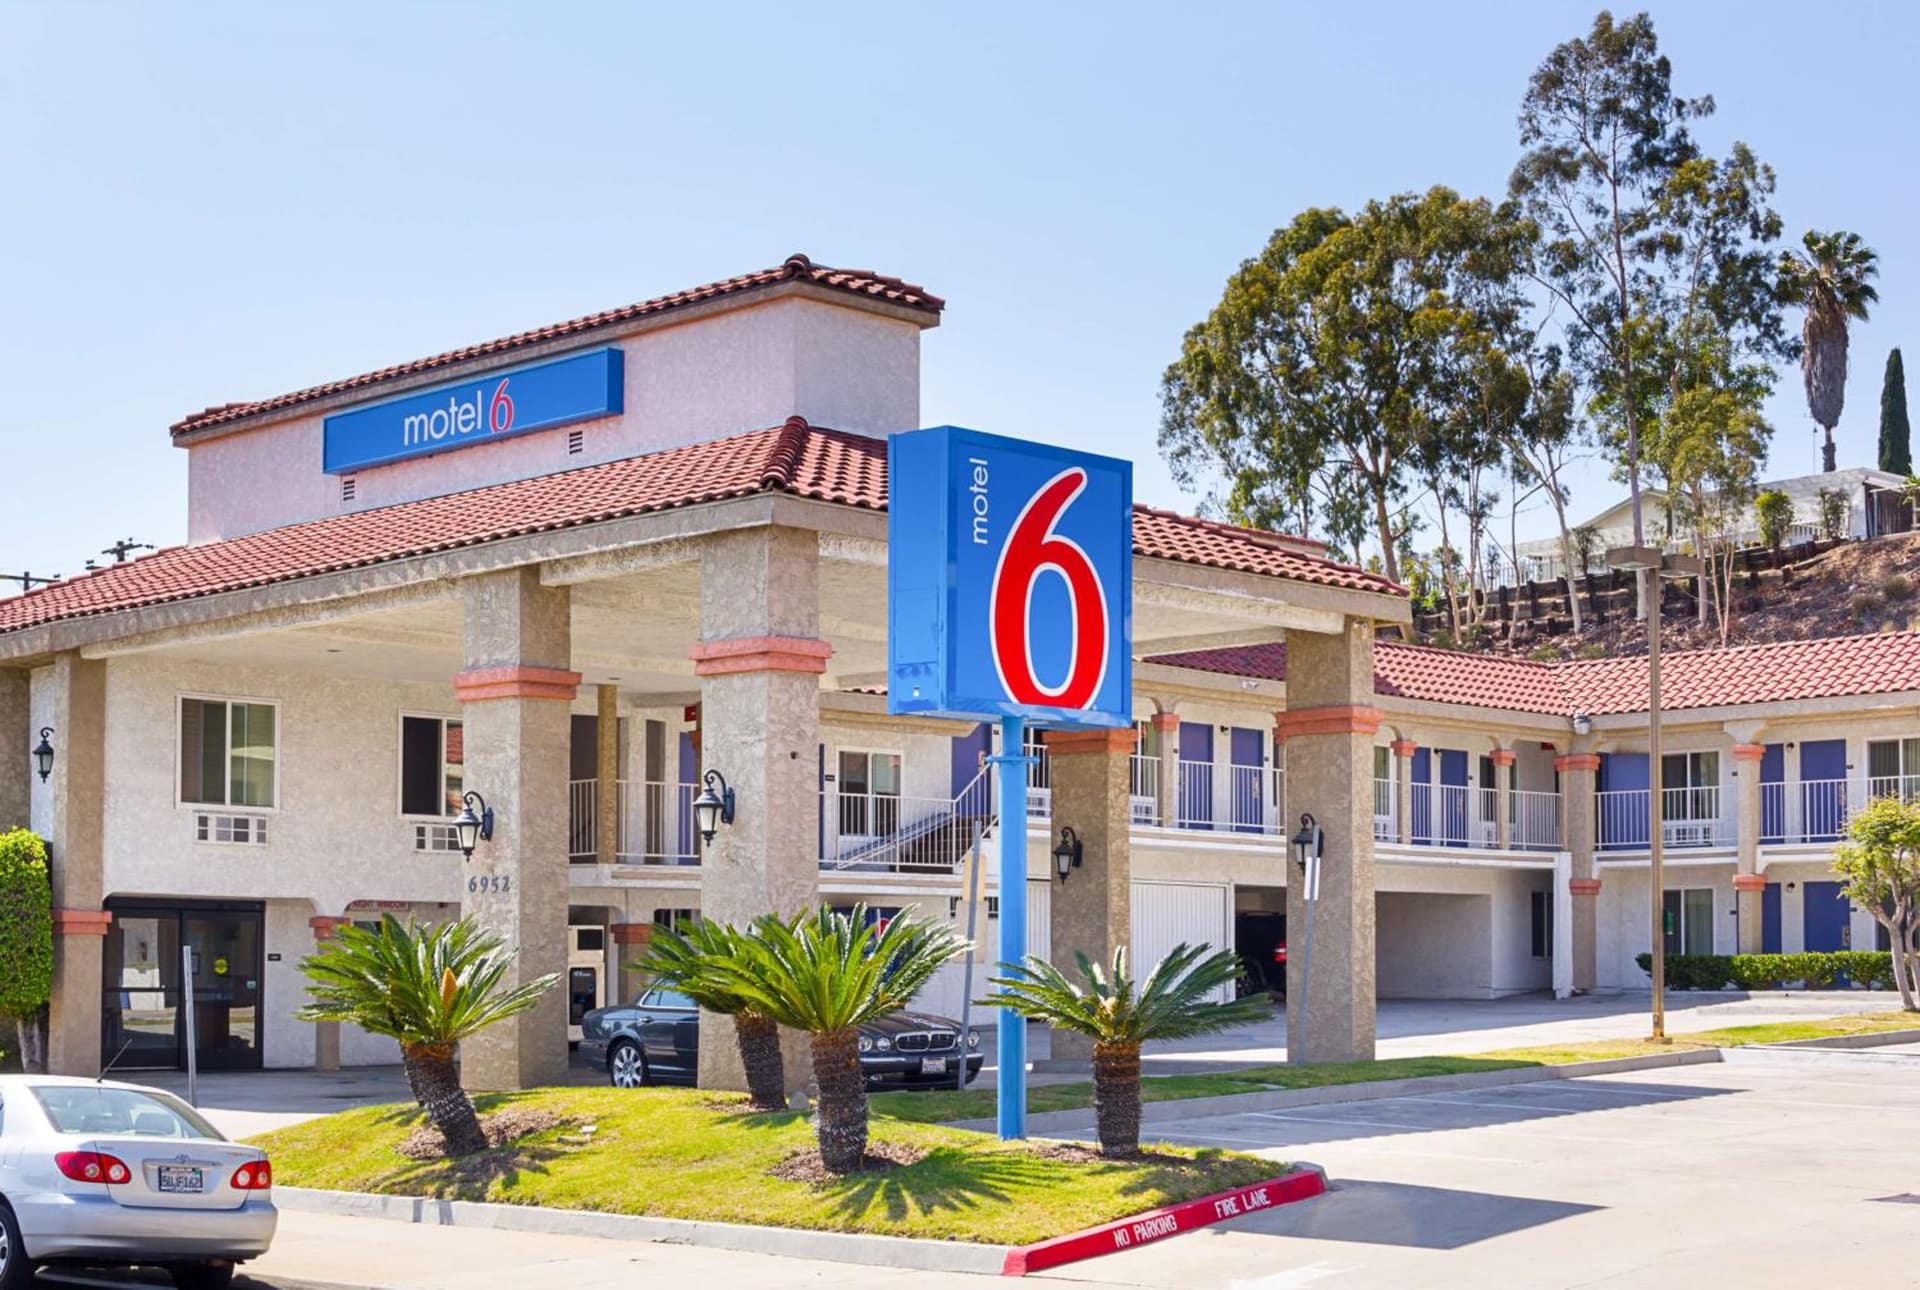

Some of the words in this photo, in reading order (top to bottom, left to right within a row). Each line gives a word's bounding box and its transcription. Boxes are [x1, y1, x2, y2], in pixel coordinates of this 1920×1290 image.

[403, 390, 482, 446] motel
[489, 377, 515, 434] 6
[969, 457, 988, 545] motel
[989, 466, 1110, 710] 6
[468, 875, 511, 895] 6952
[1215, 1197, 1239, 1218] FIRE
[1242, 1188, 1270, 1209] LANE
[1113, 1229, 1130, 1248] NO
[1134, 1215, 1177, 1241] PARKING
